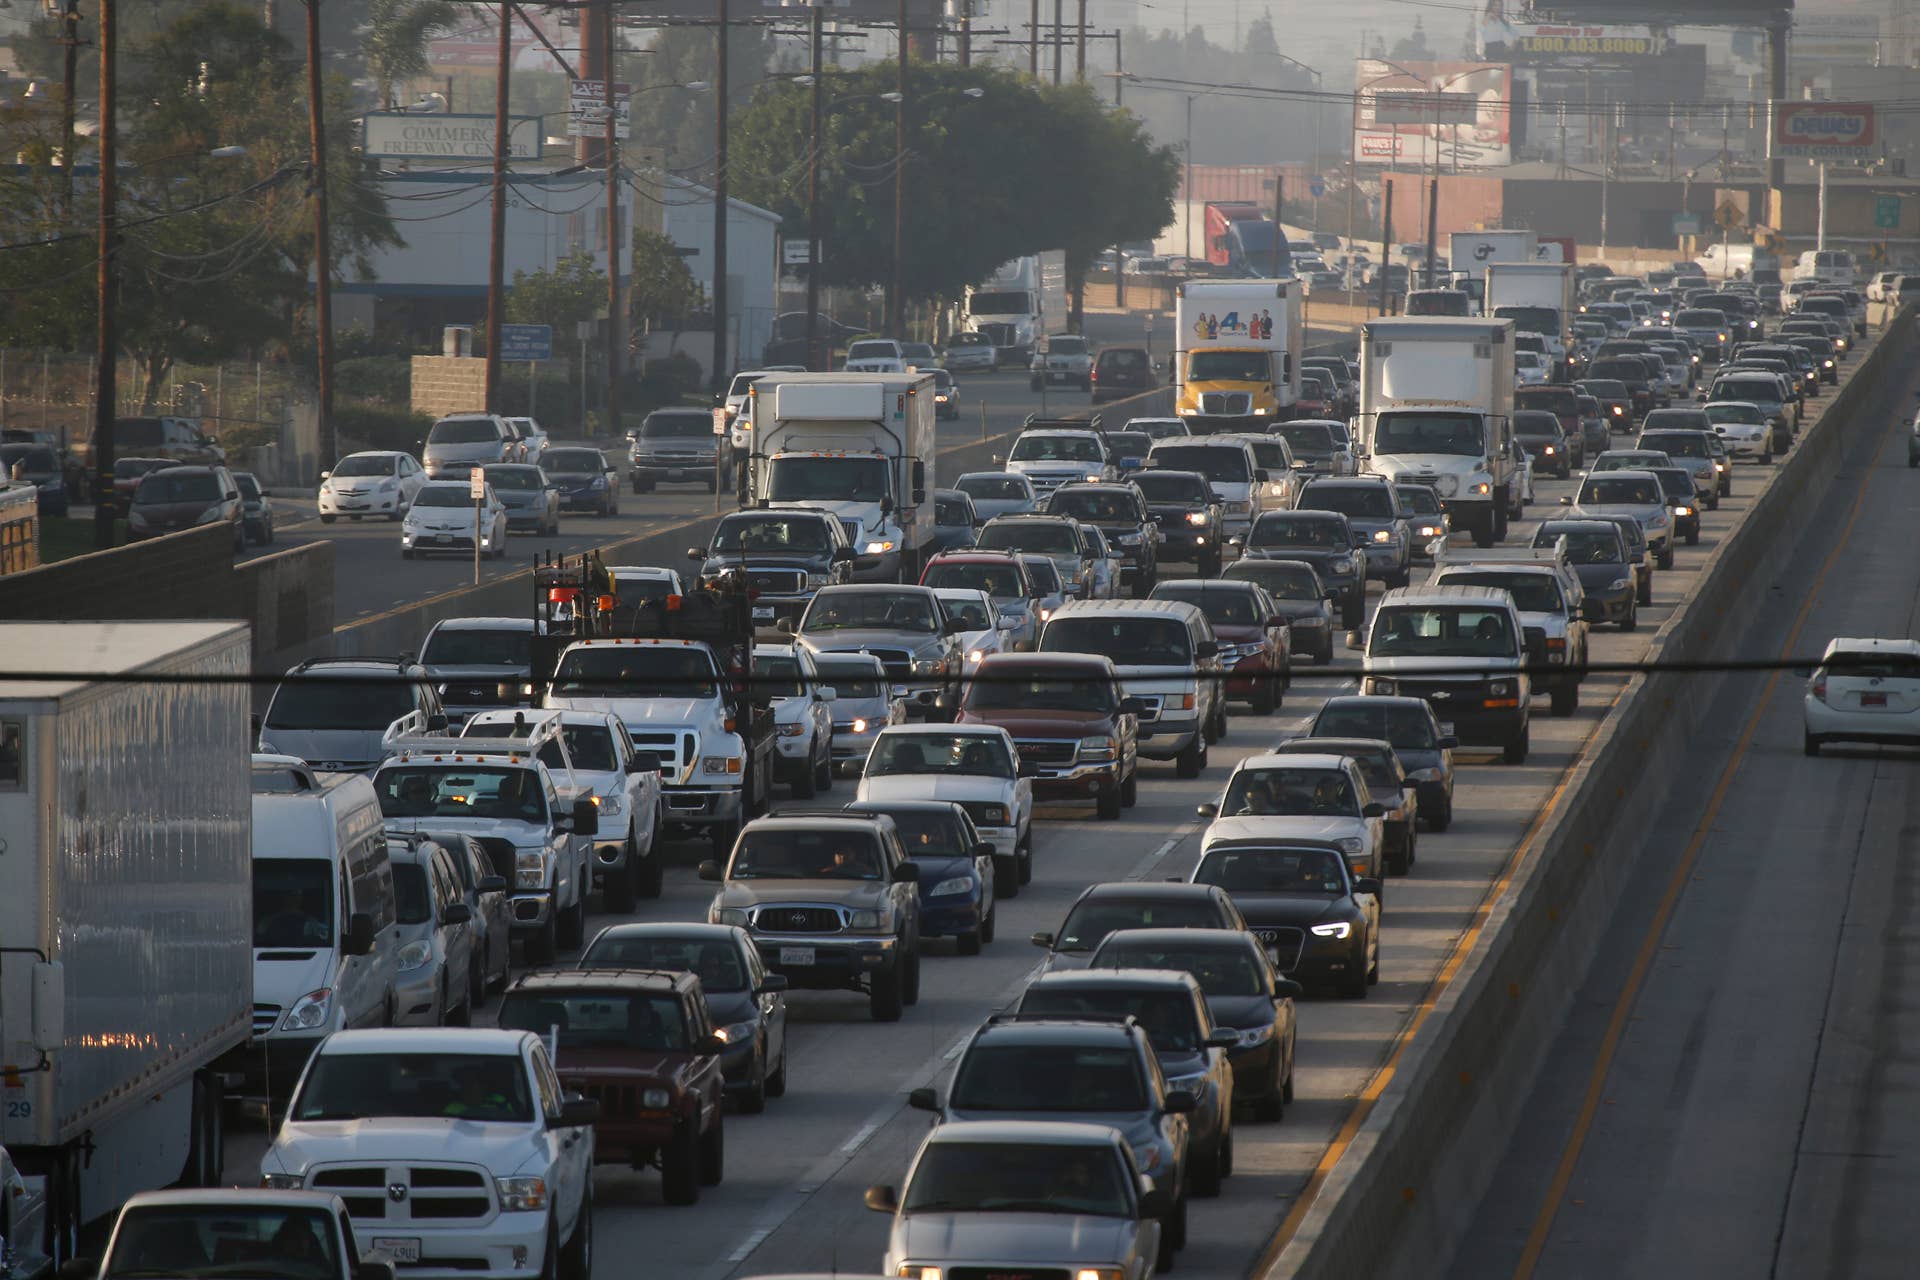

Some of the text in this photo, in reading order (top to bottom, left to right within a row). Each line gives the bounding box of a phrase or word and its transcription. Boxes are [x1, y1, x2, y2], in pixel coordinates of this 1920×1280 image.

[402, 126, 497, 141] COMMERC
[384, 141, 529, 156] FREEWAY CENER
[8, 1102, 31, 1118] 29
